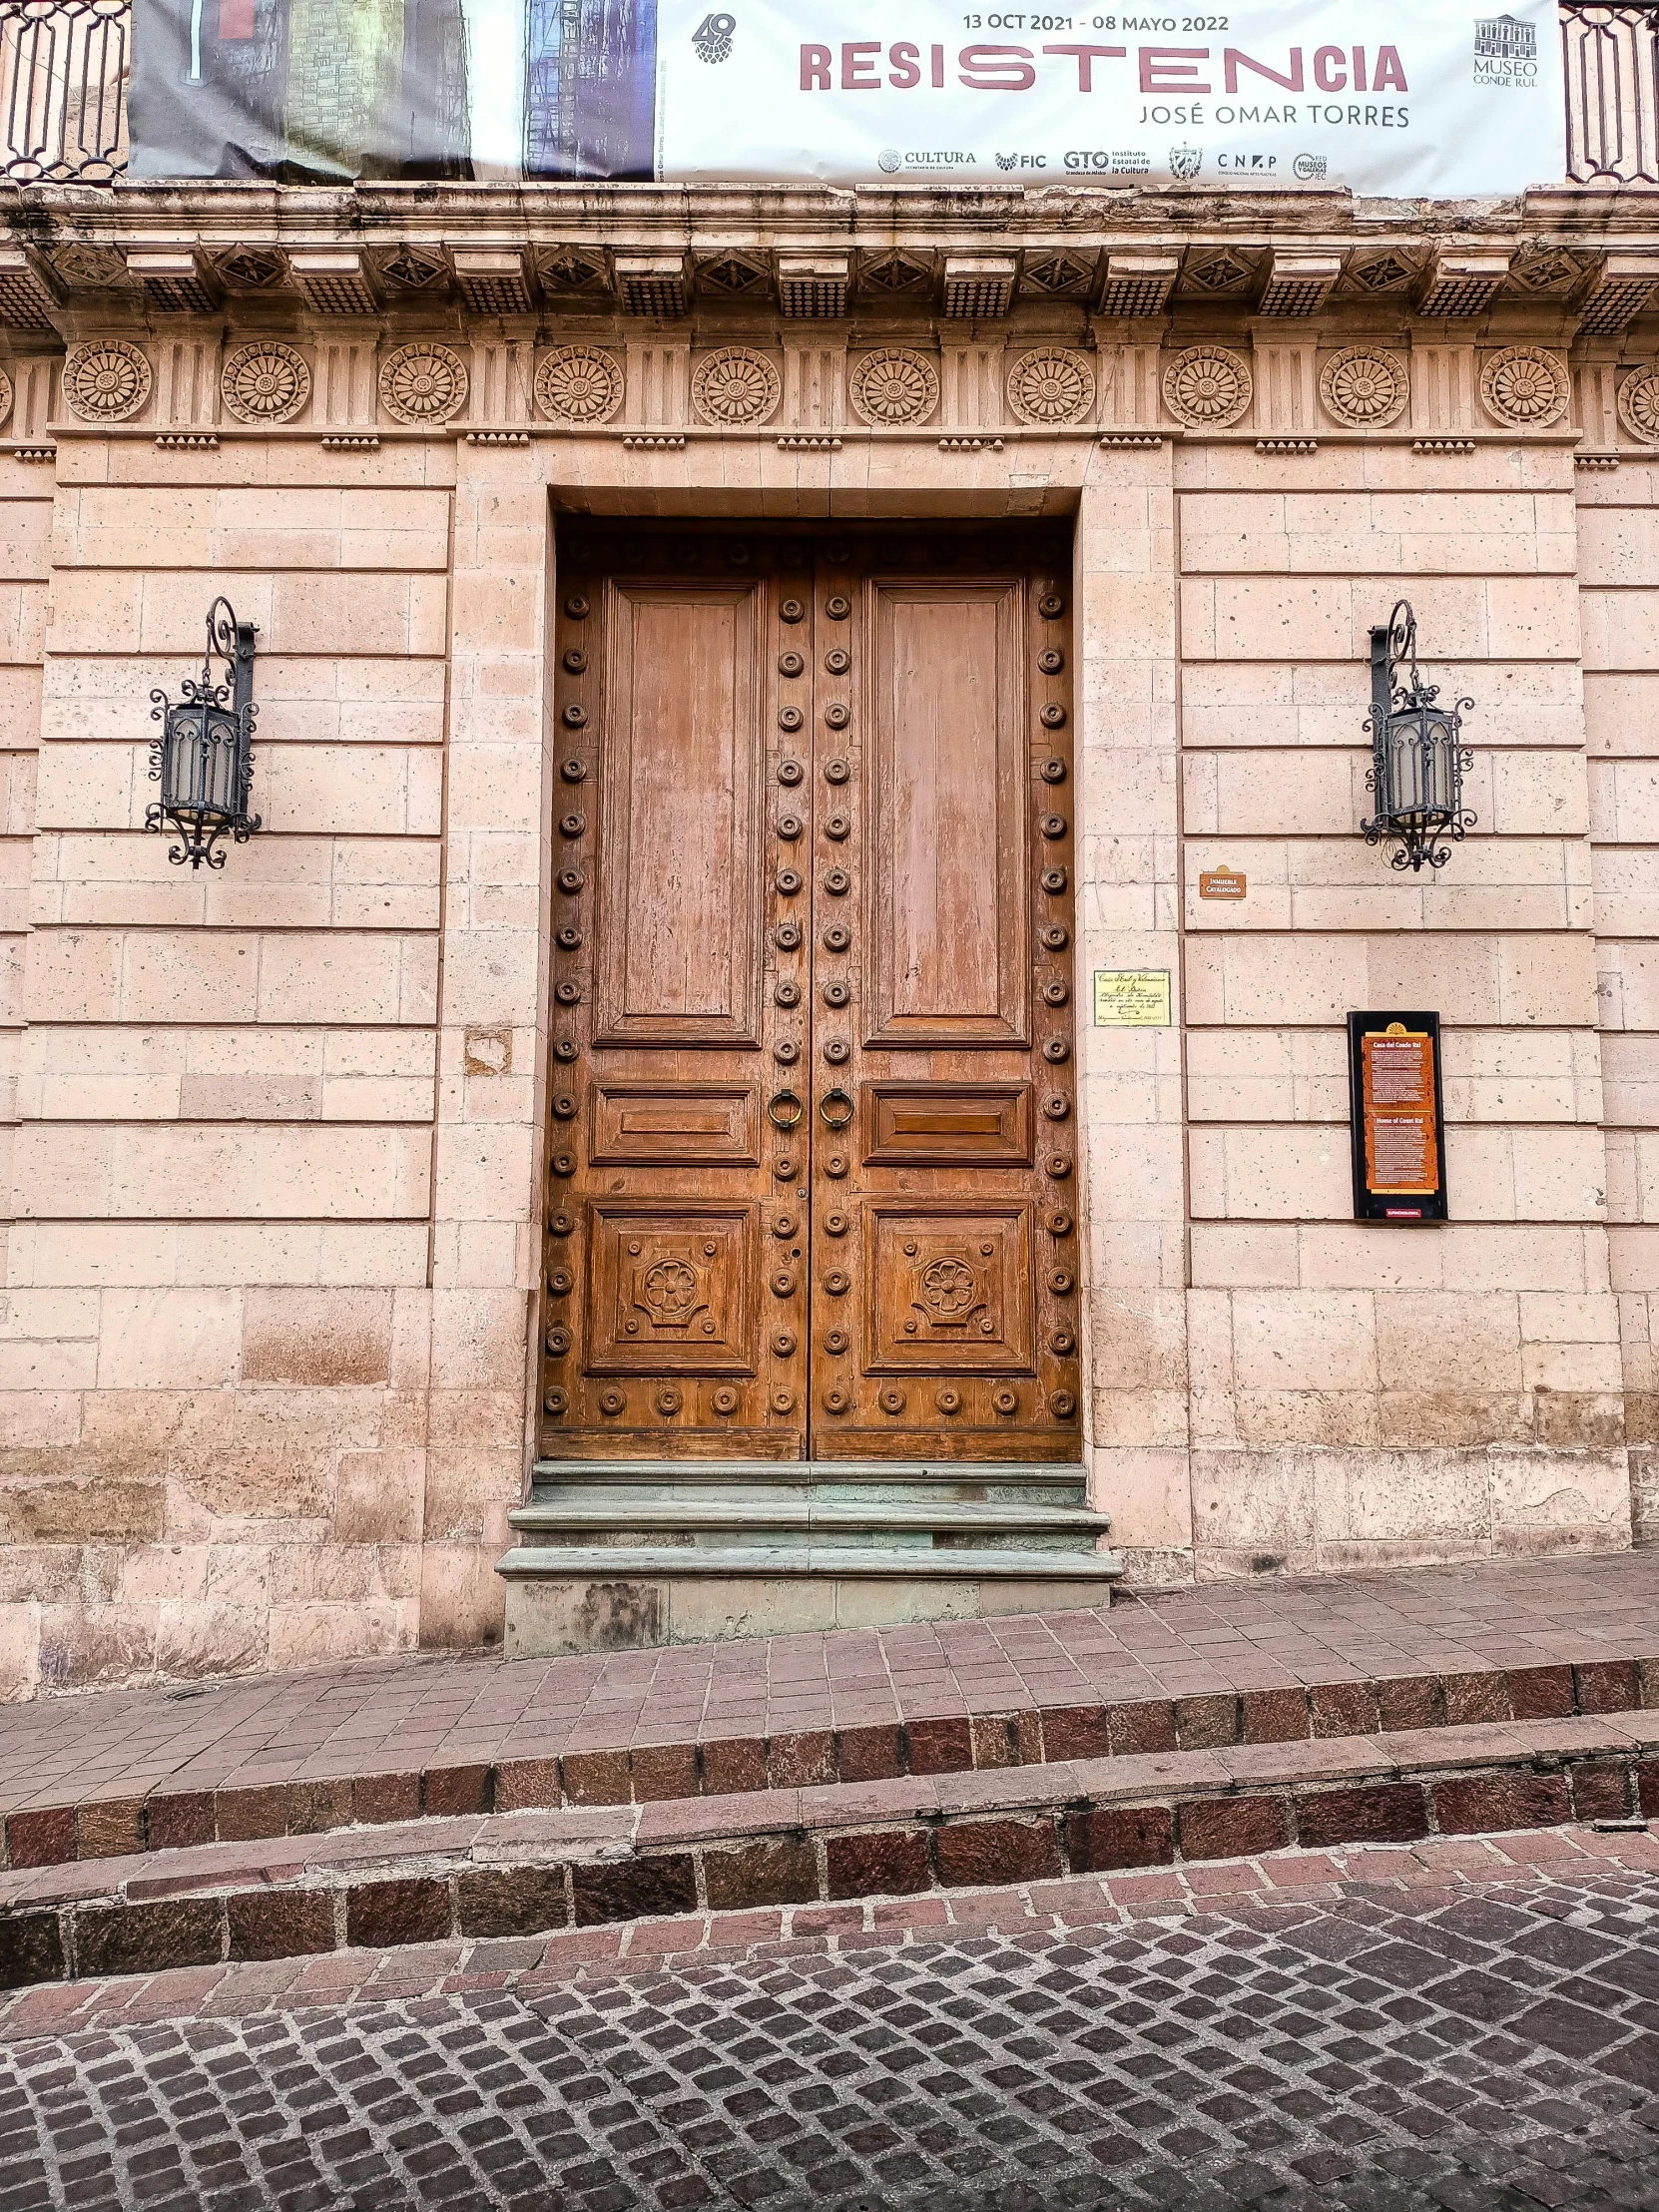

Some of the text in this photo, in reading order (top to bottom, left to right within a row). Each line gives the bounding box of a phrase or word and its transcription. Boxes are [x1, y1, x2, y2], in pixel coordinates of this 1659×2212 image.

[692, 13, 737, 45] 49
[963, 14, 982, 29] 13
[987, 14, 1026, 29] OCT
[1030, 15, 1073, 30] 2021
[1092, 16, 1117, 30] 08
[1122, 17, 1177, 31] MAYO
[1182, 16, 1230, 31] 2022
[800, 42, 1408, 93] RESISTENCIA
[1473, 59, 1538, 76] MUSEO
[1473, 75, 1538, 87] CONDE RUL
[1139, 102, 1409, 128] JOSÉ OMAR TORRES
[904, 151, 977, 163] CULTURA
[1021, 155, 1047, 168] FIC
[1064, 151, 1109, 169] GTO
